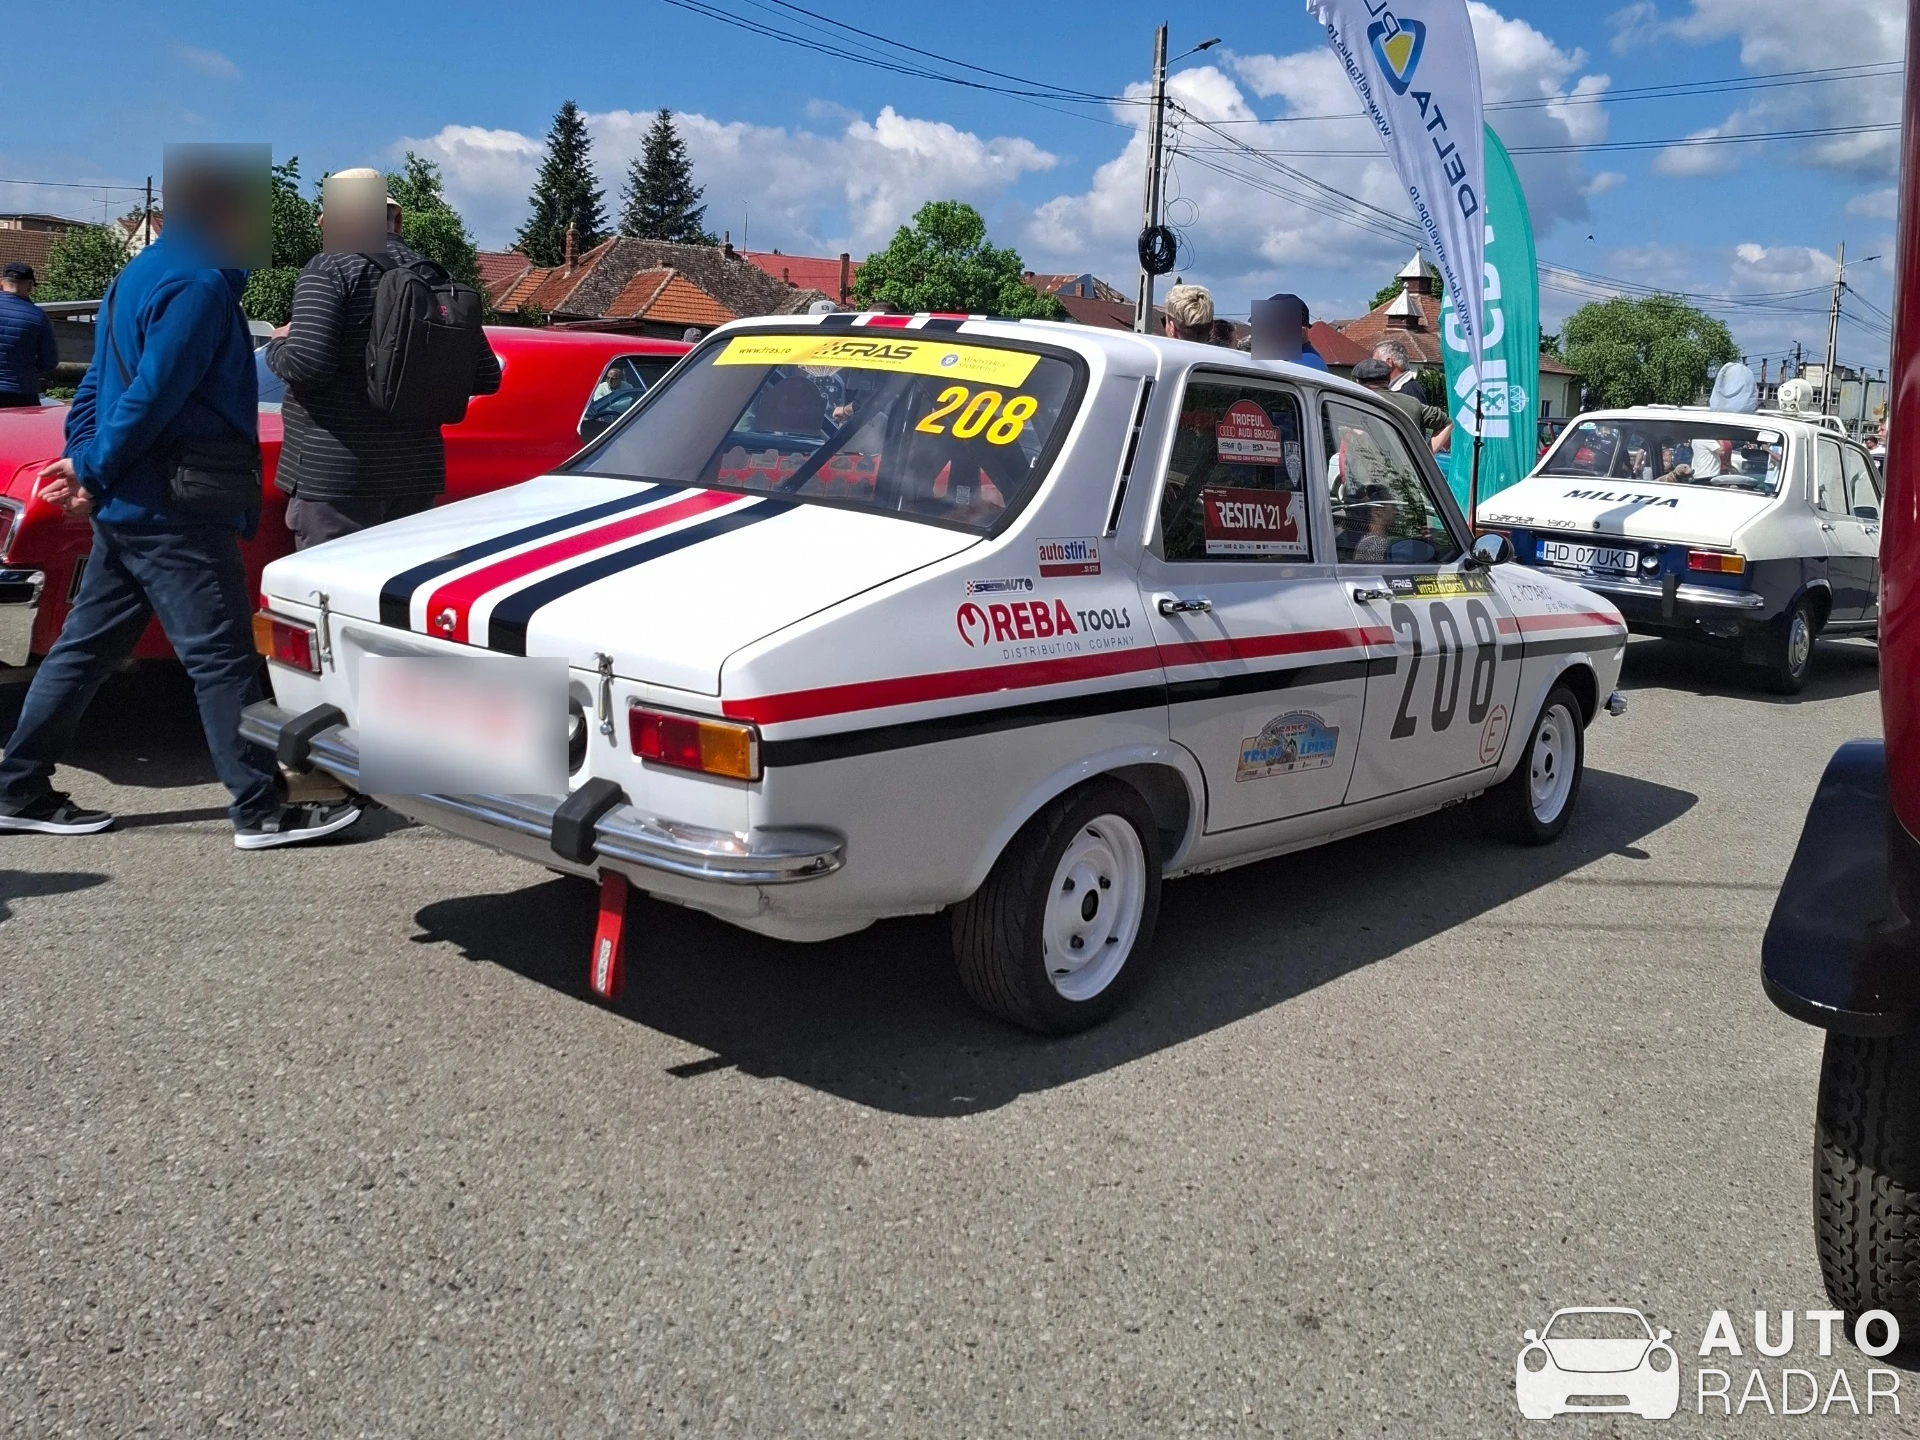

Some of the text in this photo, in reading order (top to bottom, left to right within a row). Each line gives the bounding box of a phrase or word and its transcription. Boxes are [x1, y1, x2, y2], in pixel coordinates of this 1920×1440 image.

[738, 346, 792, 354] www.fras.ro
[841, 342, 919, 360] FRAS
[914, 386, 1038, 445] 208
[1231, 412, 1265, 427] TROFEUL
[1238, 429, 1253, 439] AUDI
[1563, 489, 1680, 508] MILITIA
[1039, 540, 1097, 561] autostiri.ro
[1543, 541, 1571, 562] HD
[988, 598, 1131, 642] REBA TOOLS
[1003, 635, 1135, 660] DISTRIBUTION COMPANY
[1390, 599, 1497, 740] 208
[1484, 715, 1502, 753] E
